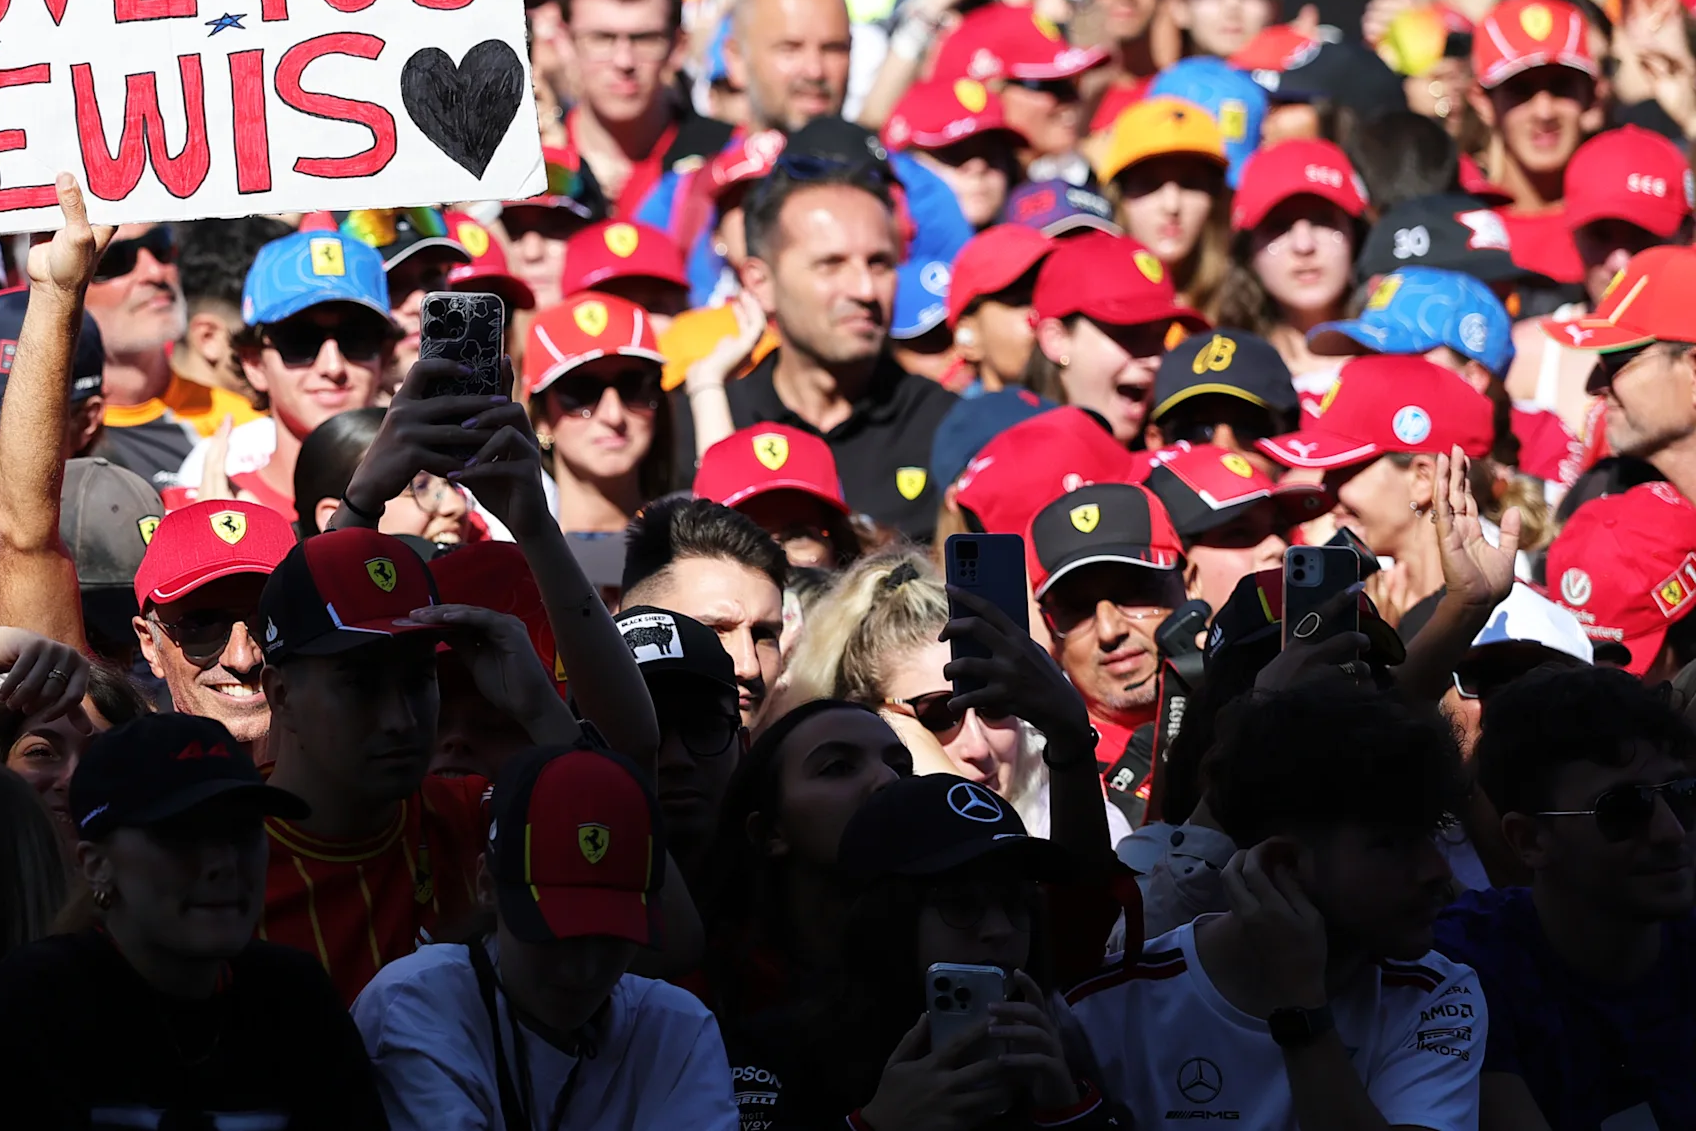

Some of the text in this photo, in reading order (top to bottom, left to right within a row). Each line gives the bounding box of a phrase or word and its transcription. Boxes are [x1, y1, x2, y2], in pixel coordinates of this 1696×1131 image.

[1393, 225, 1431, 260] 30
[730, 1065, 783, 1089] PSON
[735, 1090, 779, 1106] ELLI
[739, 1111, 766, 1121] RIOTT
[1187, 1110, 1240, 1120] AMG
